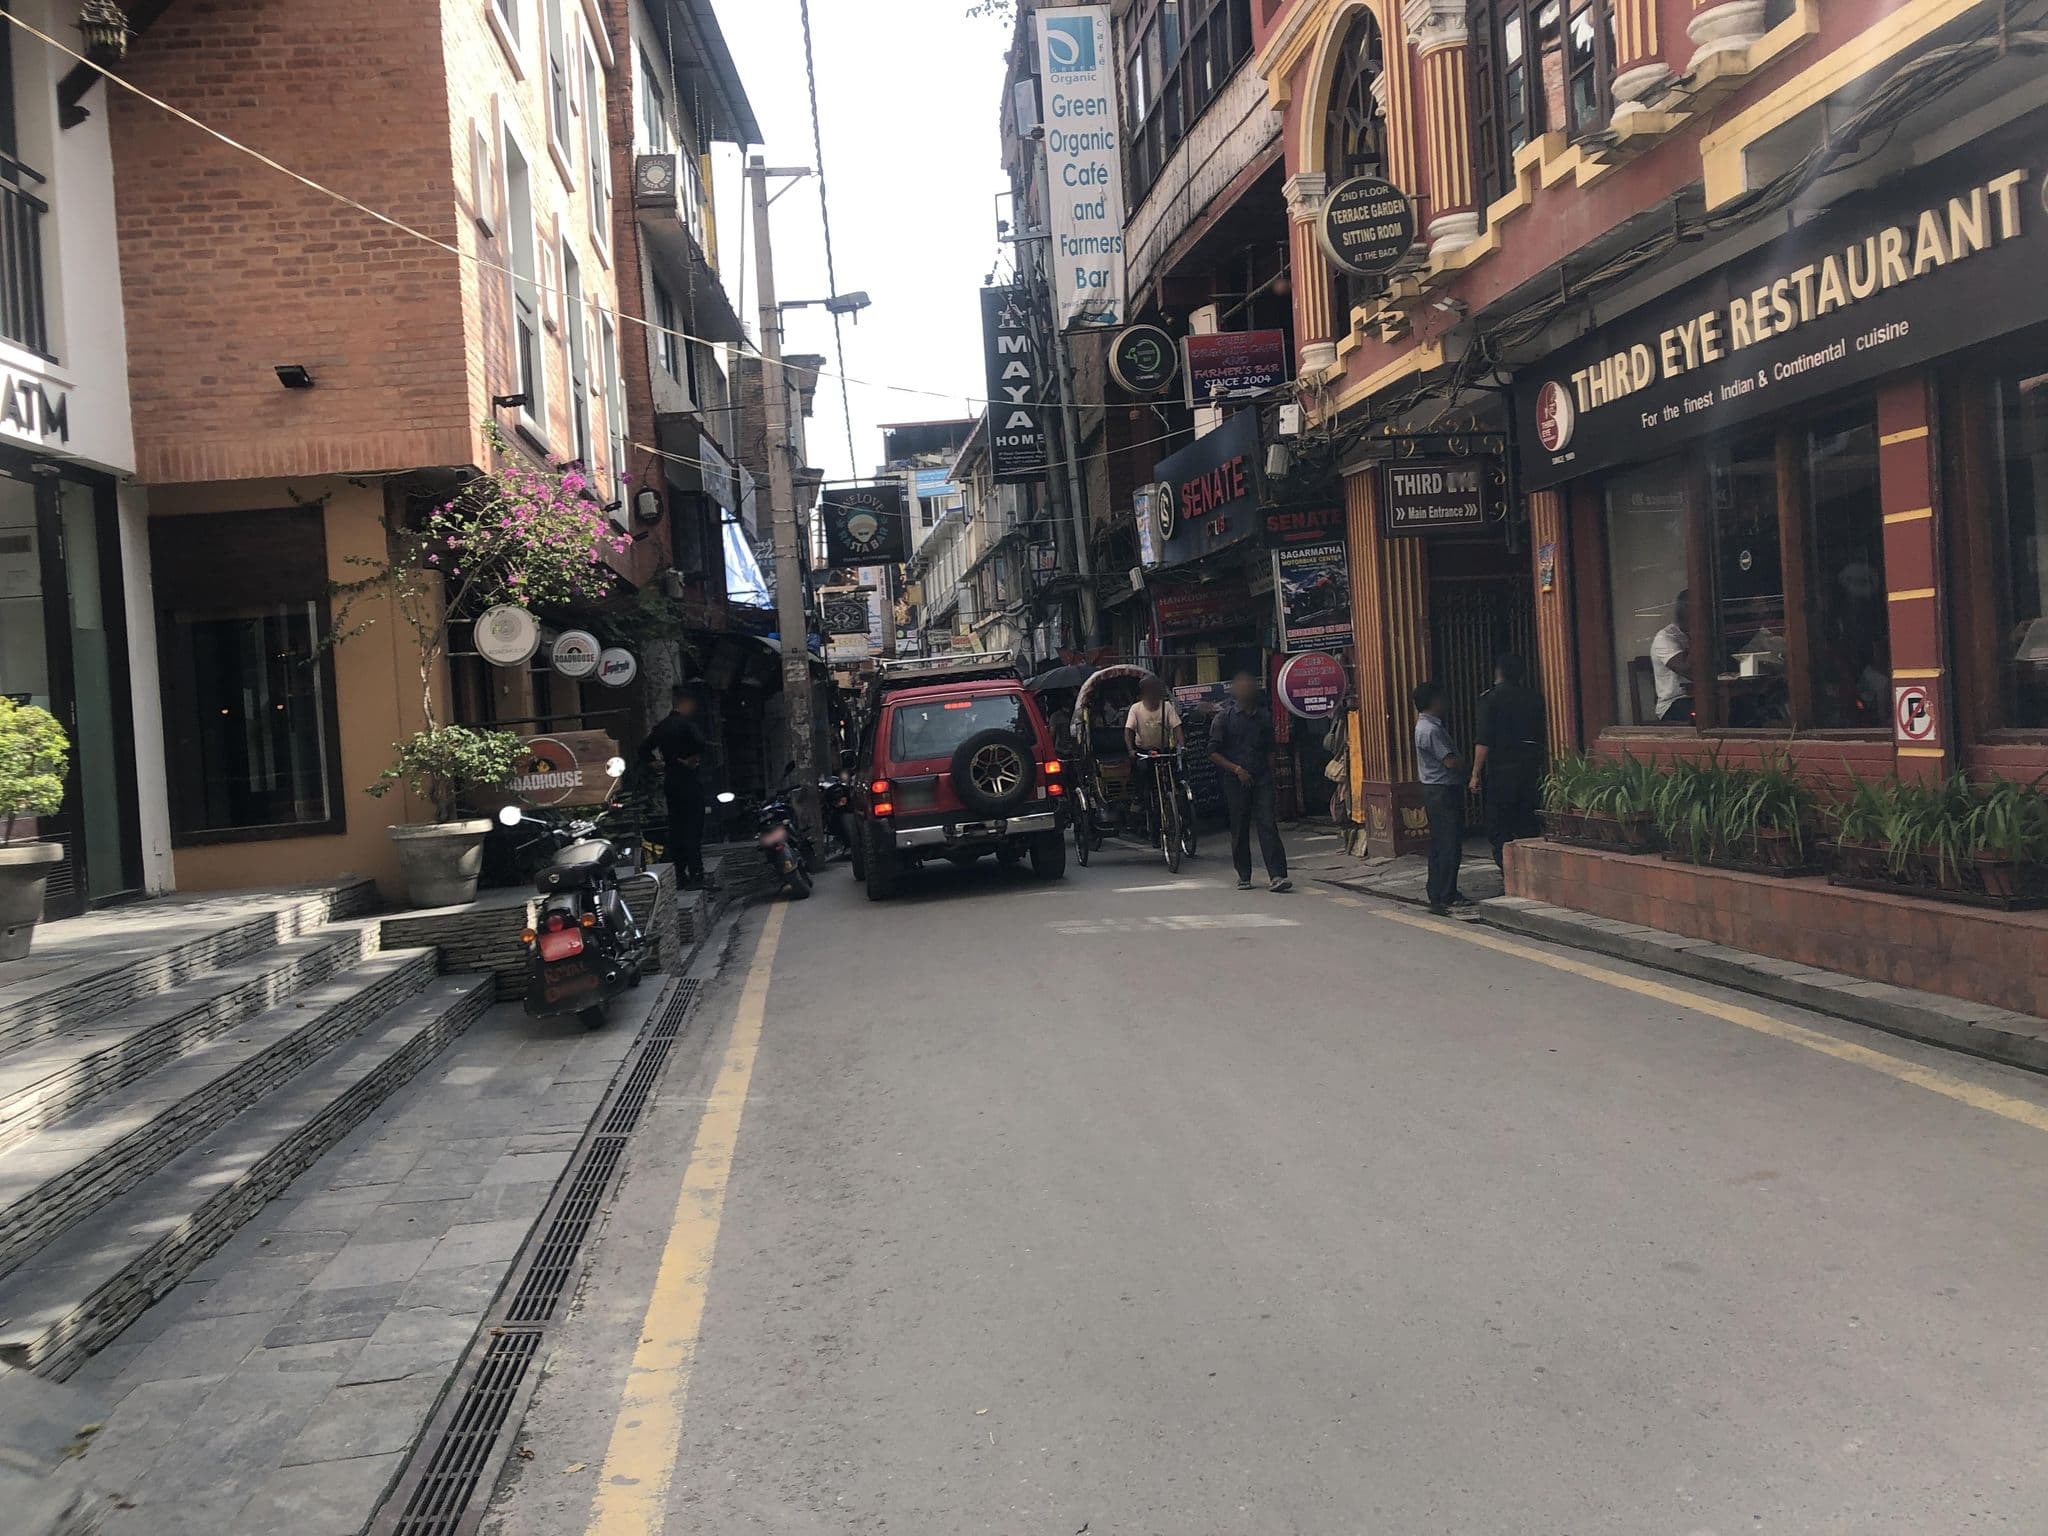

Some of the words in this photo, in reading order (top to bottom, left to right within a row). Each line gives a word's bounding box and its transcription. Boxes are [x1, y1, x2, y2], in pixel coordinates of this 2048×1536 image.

[1050, 73, 1097, 85] Organic
[1052, 93, 1107, 118] Green
[1049, 126, 1115, 157] Organic
[1063, 161, 1108, 187] Café
[1340, 191, 1358, 202] 2ND
[1359, 185, 1390, 199] FLOOR
[1074, 196, 1105, 221] and
[1331, 205, 1370, 225] TERRACE
[1370, 199, 1406, 218] GARDEN
[1060, 233, 1122, 257] Farmers
[1342, 227, 1376, 246] SITTING
[1377, 222, 1403, 239] ROOM
[1354, 253, 1363, 262] AT
[1364, 250, 1377, 260] THE
[1378, 246, 1399, 258] BACK
[1075, 267, 1109, 289] Bar
[1571, 343, 1655, 414] THIRD
[1660, 310, 1724, 379] EYE
[1729, 168, 2027, 350] RESTAURANT
[997, 335, 1034, 429] MAYA
[1194, 365, 1252, 380] FARMER'S
[1254, 363, 1280, 373] BAR
[1203, 376, 1239, 389] SINCE
[1243, 374, 1272, 385] 2004
[1641, 412, 1658, 429] For
[1663, 404, 1680, 422] the
[1683, 390, 1714, 414] finest
[1720, 377, 1755, 400] Indian
[1758, 369, 1769, 388] &
[1773, 338, 1846, 381] Continental
[1856, 320, 1911, 351] cuisine
[0, 374, 69, 444] ATM
[995, 433, 1045, 448] HOME
[1180, 455, 1245, 520] SENATE
[1394, 473, 1442, 496] THIRD
[1267, 508, 1342, 532] SENATE
[1408, 507, 1427, 520] Main
[1428, 505, 1464, 519] Entrance
[1280, 545, 1342, 560] SAGARMATHA
[554, 652, 596, 664] ROADHOUSE
